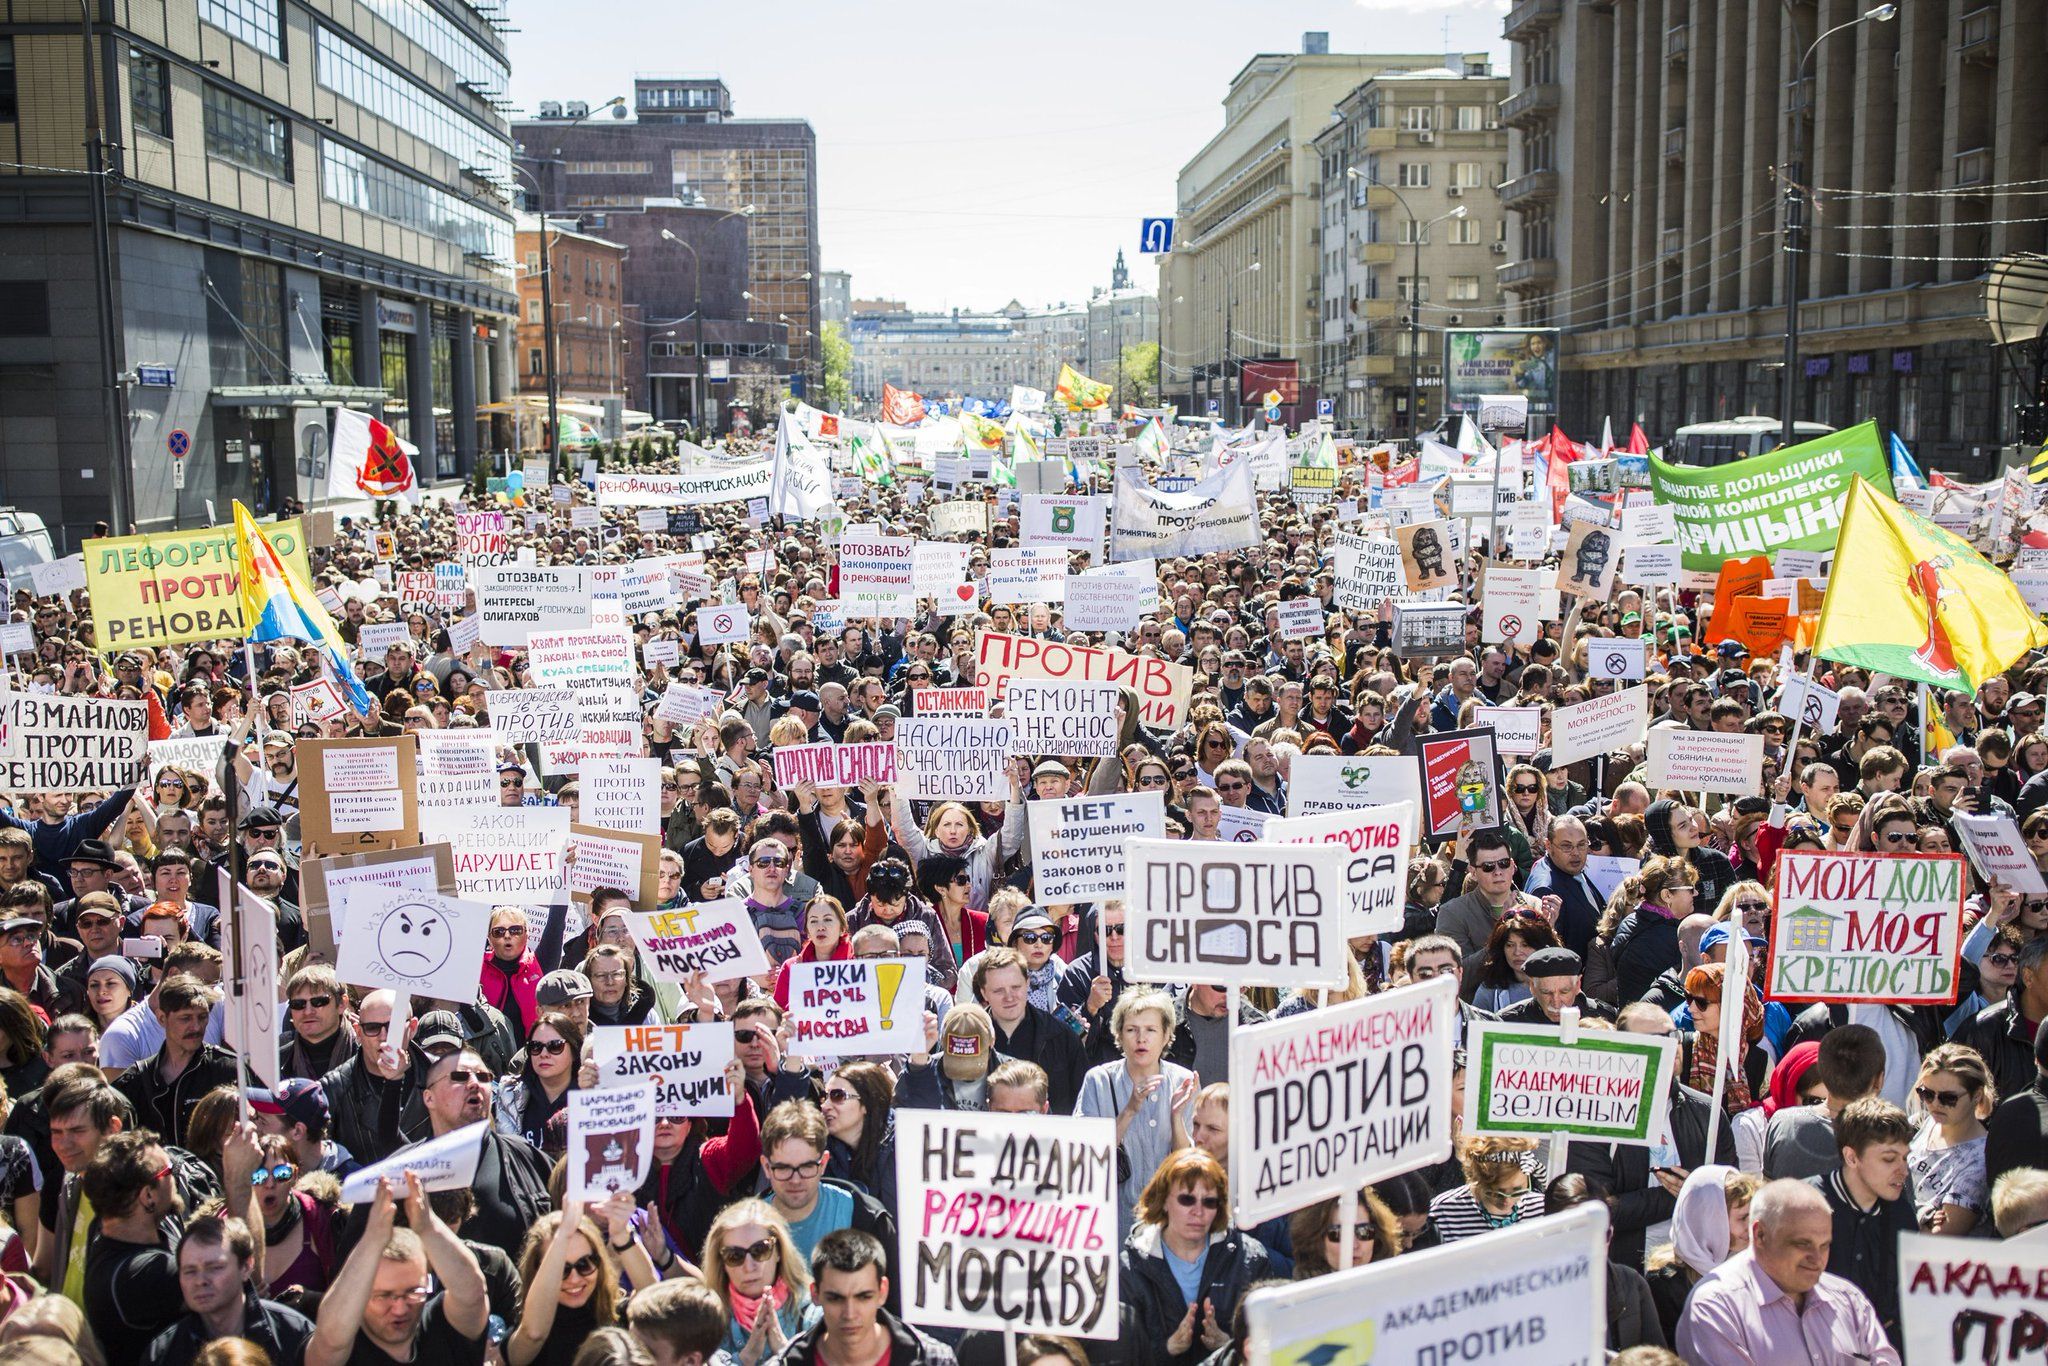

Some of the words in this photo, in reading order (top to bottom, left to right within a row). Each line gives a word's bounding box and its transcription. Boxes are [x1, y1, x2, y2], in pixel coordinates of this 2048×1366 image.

[1293, 467, 1334, 480] ПРОТИВ
[1724, 450, 1844, 499] ДОЛЬЩИКИ
[1158, 479, 1194, 491] ПРОТИВ
[1058, 499, 1089, 507] ЖИТЕЛЕЙ
[1292, 493, 1333, 503] 120505-7
[1715, 474, 1841, 518] КОМПЛЕКС
[1116, 528, 1157, 539] ПРИНЯТИЯ
[99, 532, 296, 575] ЛЕФОРТОО
[1021, 550, 1036, 558] МЫ
[1336, 533, 1402, 556] НИЖЕГОРОДС
[466, 552, 510, 569] НОСА
[842, 560, 912, 572] законопроект
[1358, 553, 1396, 569] РАЙОН
[436, 565, 464, 577] НАМ
[497, 573, 559, 583] ОТОЗВАТЬ
[842, 573, 849, 581] о
[851, 573, 911, 585] реновации!
[1019, 567, 1038, 575] НАМ
[1353, 566, 1397, 583] ПРОТИВ
[139, 572, 242, 604] ПРОТИ
[436, 580, 466, 592] СНОСУ
[1071, 582, 1103, 591] ПРОТИВ
[437, 591, 466, 606] НЕТ!
[484, 598, 535, 607] ИНТЕРЕСЫ
[483, 611, 540, 622] ОЛИГАРХОВ
[1079, 605, 1125, 615] ЗАЩИТИМ
[109, 606, 245, 642] РЕНОВА
[1074, 617, 1100, 625] НАШИ
[531, 636, 564, 650] ХВАТИТ
[568, 634, 628, 646] ПРОТАСКИВАТЬ
[536, 651, 575, 664] ЗАКОНЫ
[581, 650, 600, 660] ПОД
[600, 646, 628, 658] СНОС!
[542, 665, 574, 678] КУДА
[576, 660, 630, 674] СПЕШИМ?
[979, 633, 1173, 697] ПРОТИВ
[489, 690, 574, 705] ДОБРОСЛОБОДСКАЯ
[917, 690, 985, 711] ОСТАНКИНО
[1008, 687, 1117, 712] РЕМОНТ
[1576, 700, 1599, 715] МОЙ
[1600, 694, 1622, 709] ДОМ
[11, 699, 149, 732] ИЗМАЙЛОВО
[513, 703, 528, 714] 16
[1568, 716, 1589, 730] МОЯ
[1590, 703, 1637, 723] КРЕПОСТЬ
[496, 712, 575, 731] ПРОТИВ
[1027, 716, 1056, 738] НЕ
[1062, 716, 1115, 738] СНОС
[506, 728, 582, 743] РЕНОВАЦИИ
[897, 724, 1010, 747] НАСИЛЬНО
[1697, 737, 1746, 745] реновацию!
[25, 734, 134, 759] ПРОТИВ
[1035, 739, 1117, 756] КРИВОРОЖСКАЯ
[1687, 746, 1740, 755] переселение
[775, 746, 835, 787] ПРОТИВ
[839, 745, 898, 785] СНОСА
[897, 749, 1010, 772] ОСЧАСТЛИВИТЬ
[1668, 753, 1713, 763] СОБЯНИНА
[609, 763, 631, 774] МЫ
[1671, 764, 1742, 774] благоустроенные
[420, 779, 492, 794] СОХРАНИМ
[593, 777, 645, 788] ПРОТИВ
[918, 771, 995, 796] НЕЛЬЗЯ!
[1699, 775, 1747, 785] КОГАЛЫМА!
[334, 796, 373, 804] ПРОТИВ
[417, 795, 497, 808] МАЛОЭТАЖНУЮ
[597, 791, 642, 801] СНОСА
[594, 806, 645, 817] КОНСТИ
[1062, 801, 1116, 823] НЕТ
[1304, 801, 1343, 811] ПРАВО
[472, 813, 526, 831] ЗАКОН
[595, 819, 643, 830] ТУЦИИ!
[1051, 822, 1146, 842] нарушению
[453, 852, 557, 874] НАРУШАЕТ
[1042, 844, 1124, 863] конституц
[329, 868, 396, 888] БАСМАННЫЙ
[397, 866, 433, 878] РАЙОН
[1042, 864, 1102, 879] законов
[1105, 866, 1114, 875] о
[1044, 878, 1125, 898] собственн
[1146, 861, 1323, 917] ПРОТИВ
[1782, 857, 1883, 901] МОЙ
[1881, 859, 1959, 911] ДОМ
[363, 890, 461, 931] ИЗМАЙЛОВО
[648, 909, 700, 938] НЕТ
[643, 921, 737, 951] УПЛОТНЕНИЮ
[1145, 918, 1321, 967] СНОСА
[1842, 911, 1948, 957] МОЯ
[657, 939, 742, 974] МОСКВЫ
[366, 961, 434, 989] ПРОТИВ
[814, 963, 867, 988] РУКИ
[1774, 955, 1952, 995] КРЕПОСТЬ
[803, 987, 866, 1008] ПРОЧЬ
[798, 1016, 869, 1042] МОСКВЫ
[625, 1025, 691, 1053] НЕТ
[1253, 998, 1433, 1085] АКАДЕМИЧЕСКИЙ
[615, 1051, 702, 1076] ЗАКОНУ
[1499, 1047, 1640, 1074] СОХРАНИМ
[1494, 1069, 1641, 1099] АКАДЕМИЧЕСКИЙ
[580, 1090, 645, 1107] ЦАРИЦЫНО
[1254, 1043, 1430, 1150] ПРОТИВ
[590, 1104, 636, 1117] ПРОТИВ
[578, 1113, 648, 1130] РЕНОВАЦИИ
[1255, 1105, 1430, 1199] ДЕПОРТАЦИИ
[922, 1123, 977, 1183] НЕ
[991, 1132, 1111, 1202] ДАДИМ
[922, 1189, 1104, 1251] РАЗРУШИТЬ
[915, 1241, 1110, 1333] МОСКВУ
[1909, 1260, 2048, 1301] АКАДЕ
[1382, 1254, 1590, 1334] АКАДЕМИЧЕСКИЙ
[1416, 1315, 1547, 1366] ПРОТИВ
